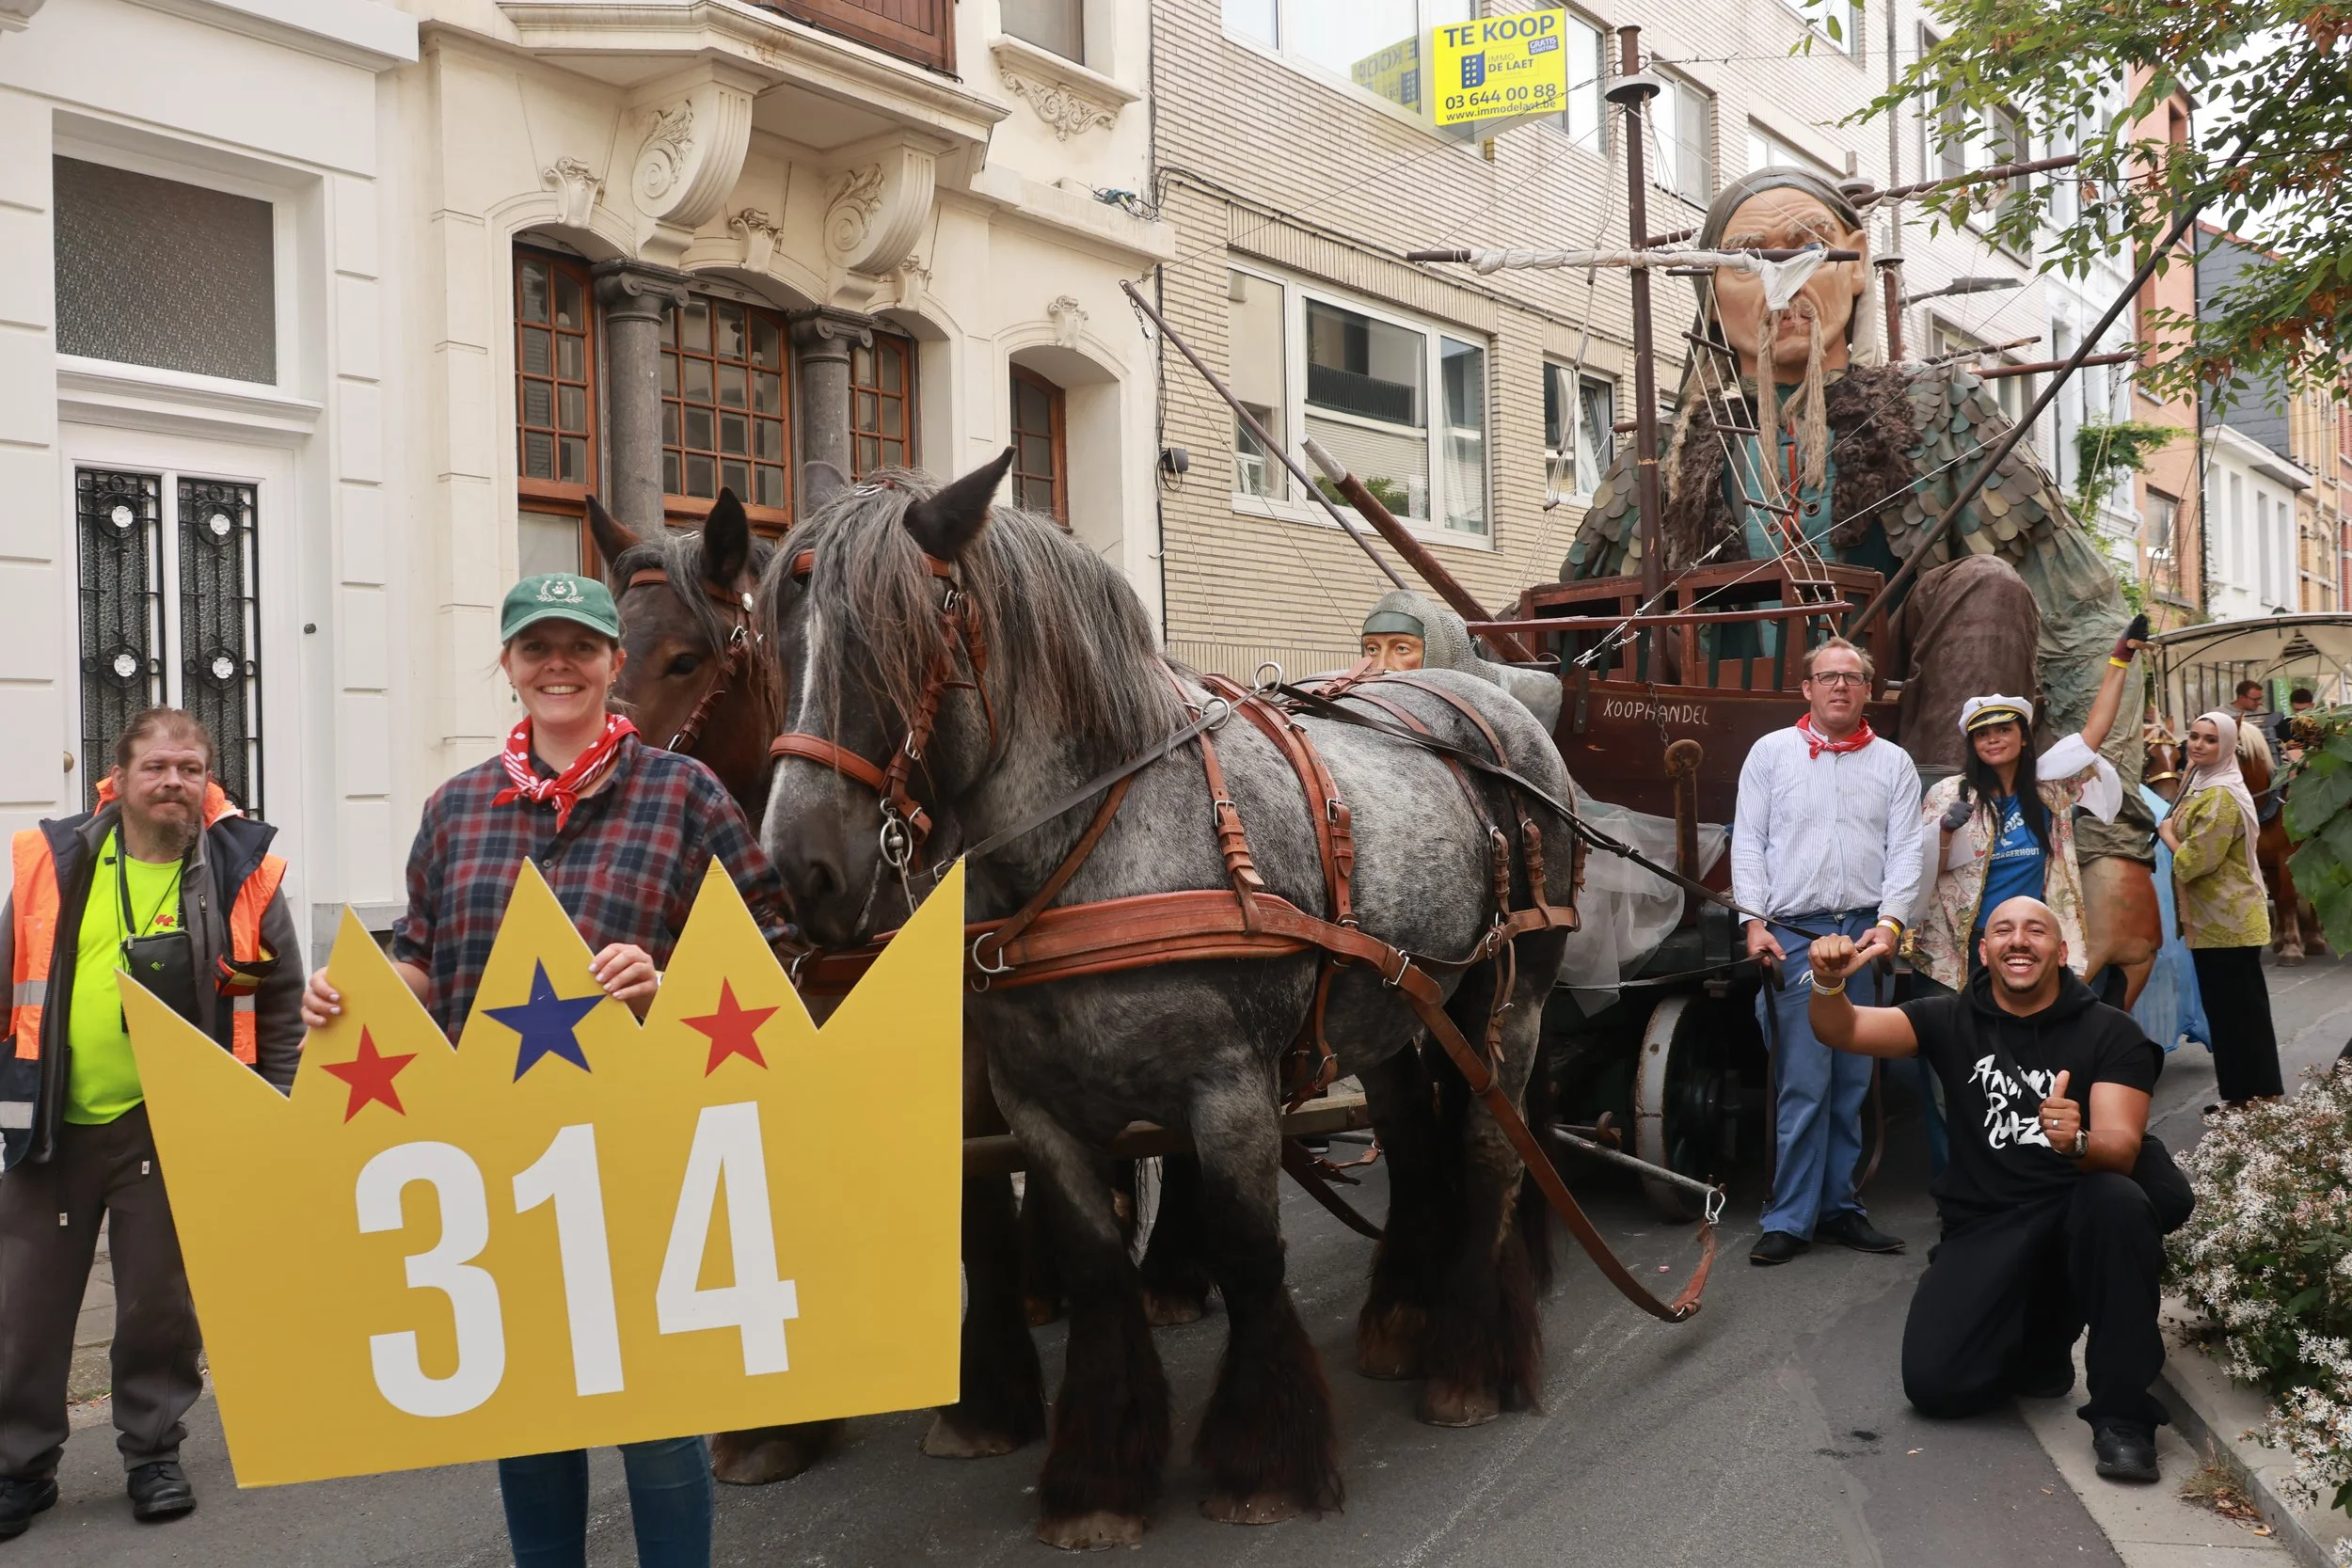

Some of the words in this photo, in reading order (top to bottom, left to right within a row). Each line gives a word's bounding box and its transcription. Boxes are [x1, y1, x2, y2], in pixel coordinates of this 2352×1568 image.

[1444, 25, 1474, 47] TE
[1483, 15, 1555, 42] KOOP
[1530, 37, 1556, 49] GRATIS
[1488, 53, 1515, 63] IMMO
[1488, 62, 1502, 72] DE
[1506, 58, 1534, 71] LAET
[1445, 94, 1465, 110] 03
[1470, 89, 1501, 106] 644
[1506, 86, 1528, 101] 00
[1534, 83, 1556, 98] 88
[1446, 98, 1556, 120] www.immodelaet.be
[1603, 698, 1709, 725] KOOPHANDEL
[355, 1101, 800, 1418] 314
